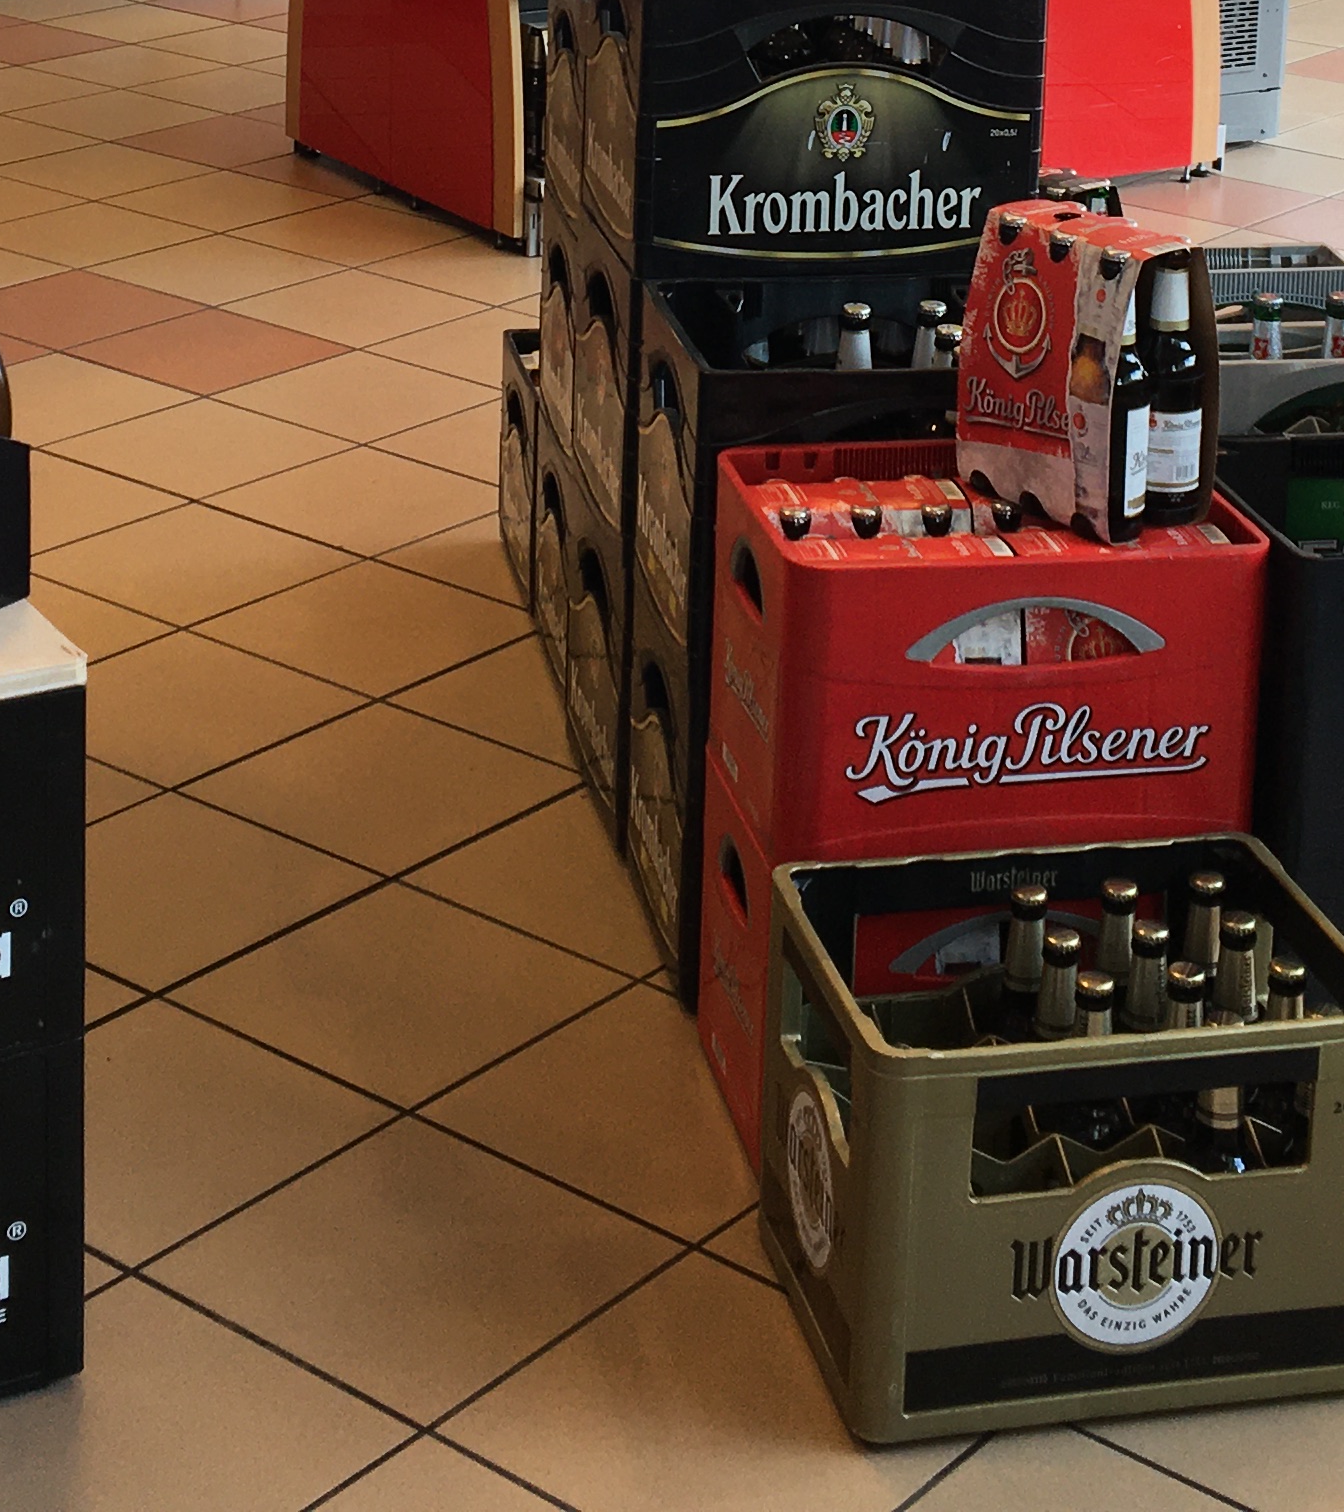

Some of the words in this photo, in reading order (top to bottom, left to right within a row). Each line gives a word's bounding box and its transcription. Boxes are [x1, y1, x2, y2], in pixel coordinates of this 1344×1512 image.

[706, 169, 982, 236] Krombacher
[963, 374, 1026, 430] König
[844, 711, 1008, 793] König
[996, 701, 1212, 768] Pilsener
[1080, 1218, 1103, 1244] SEIT
[1008, 1226, 1265, 1300] Warsteiner
[1077, 1298, 1099, 1321] DAS
[1100, 1318, 1147, 1332] EINZIG
[1151, 1287, 1192, 1324] WAHRE
